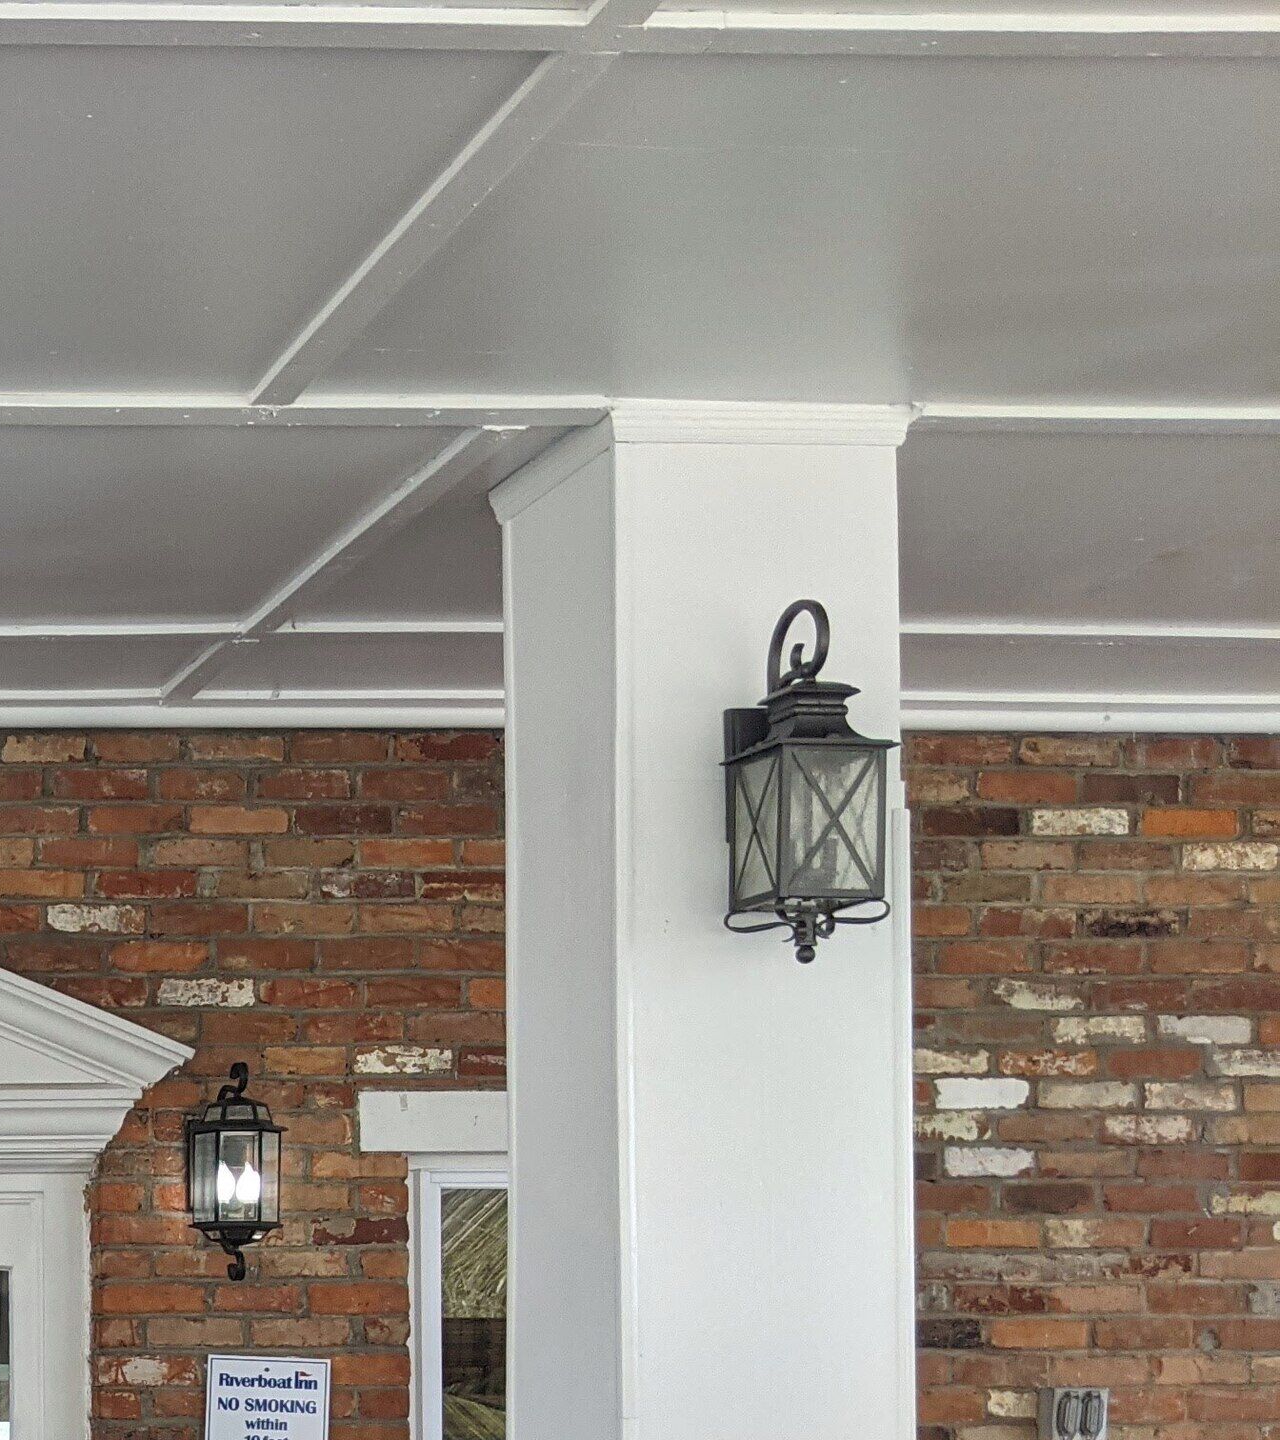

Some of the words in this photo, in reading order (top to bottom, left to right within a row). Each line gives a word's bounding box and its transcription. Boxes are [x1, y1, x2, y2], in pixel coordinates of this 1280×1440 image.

[219, 1372, 292, 1389] Riverboat
[295, 1371, 318, 1390] Inn
[217, 1397, 240, 1411] NO
[244, 1398, 317, 1414] SMOKING
[245, 1418, 288, 1431] within
